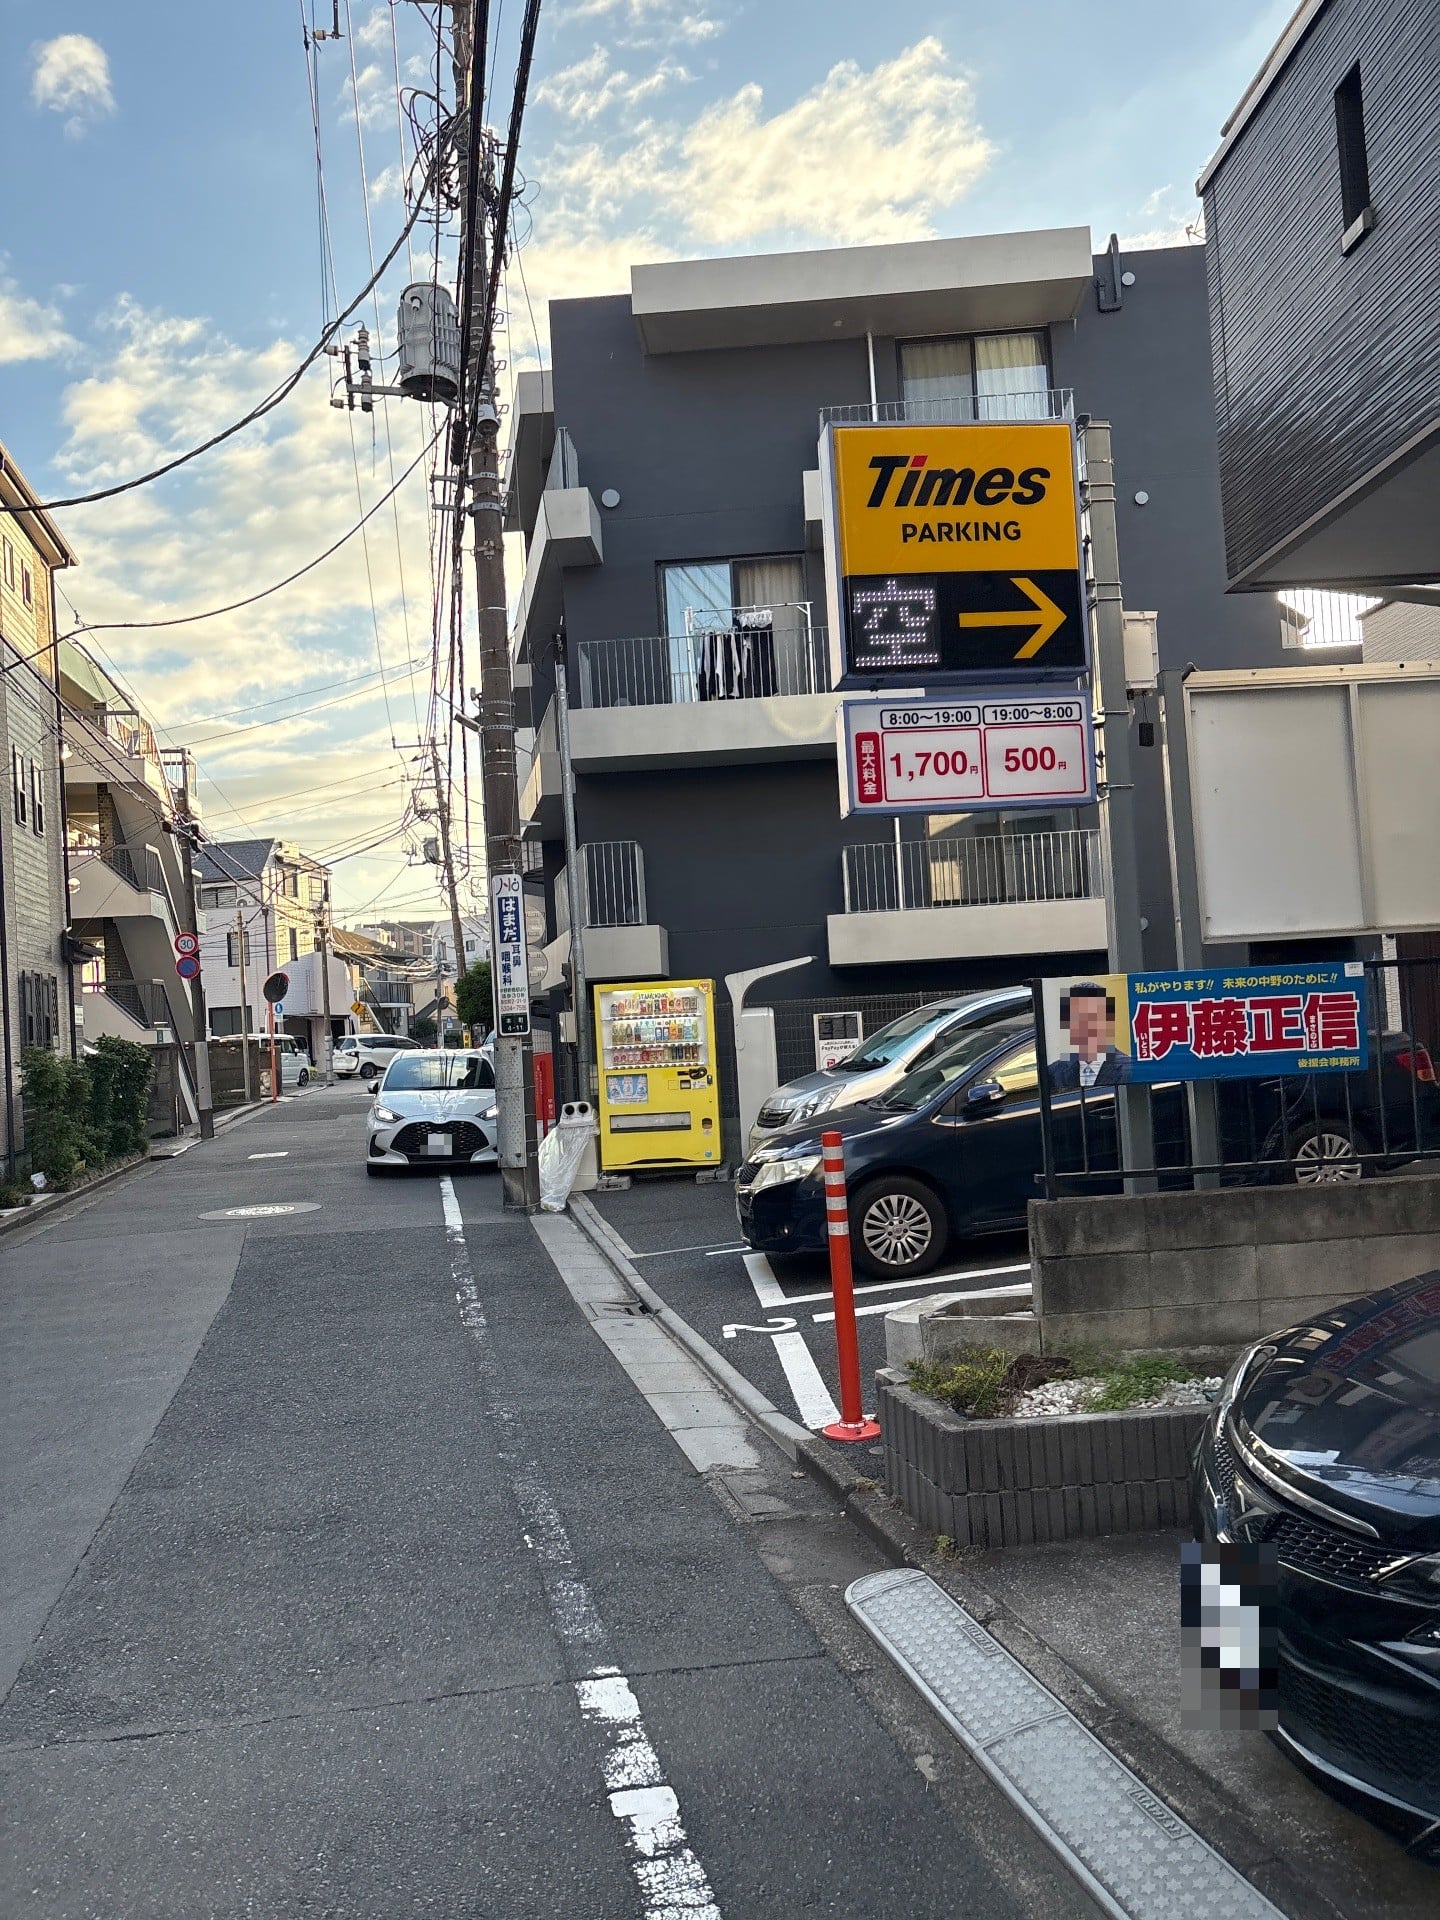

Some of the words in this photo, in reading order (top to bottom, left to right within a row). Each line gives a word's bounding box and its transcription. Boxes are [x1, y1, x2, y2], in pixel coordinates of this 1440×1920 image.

[867, 454, 1051, 508] Times
[902, 520, 1022, 543] PARKING
[853, 579, 940, 668] 空
[860, 740, 877, 796] 最大料金
[890, 750, 979, 782] 1,700円
[1004, 746, 1067, 773] 500円
[501, 898, 517, 942] はまだ
[180, 939, 193, 949] 30
[1135, 979, 1215, 994] 私がやります!!
[1222, 973, 1338, 989] 未来の中野のために!!
[507, 1024, 523, 1032] 4-11
[1132, 991, 1360, 1061] 伊藤正信
[1309, 1015, 1318, 1050] まさのぶ
[1140, 1032, 1148, 1058] いとう
[1297, 1056, 1361, 1069] 後援会事務所
[722, 1317, 798, 1339] 2
